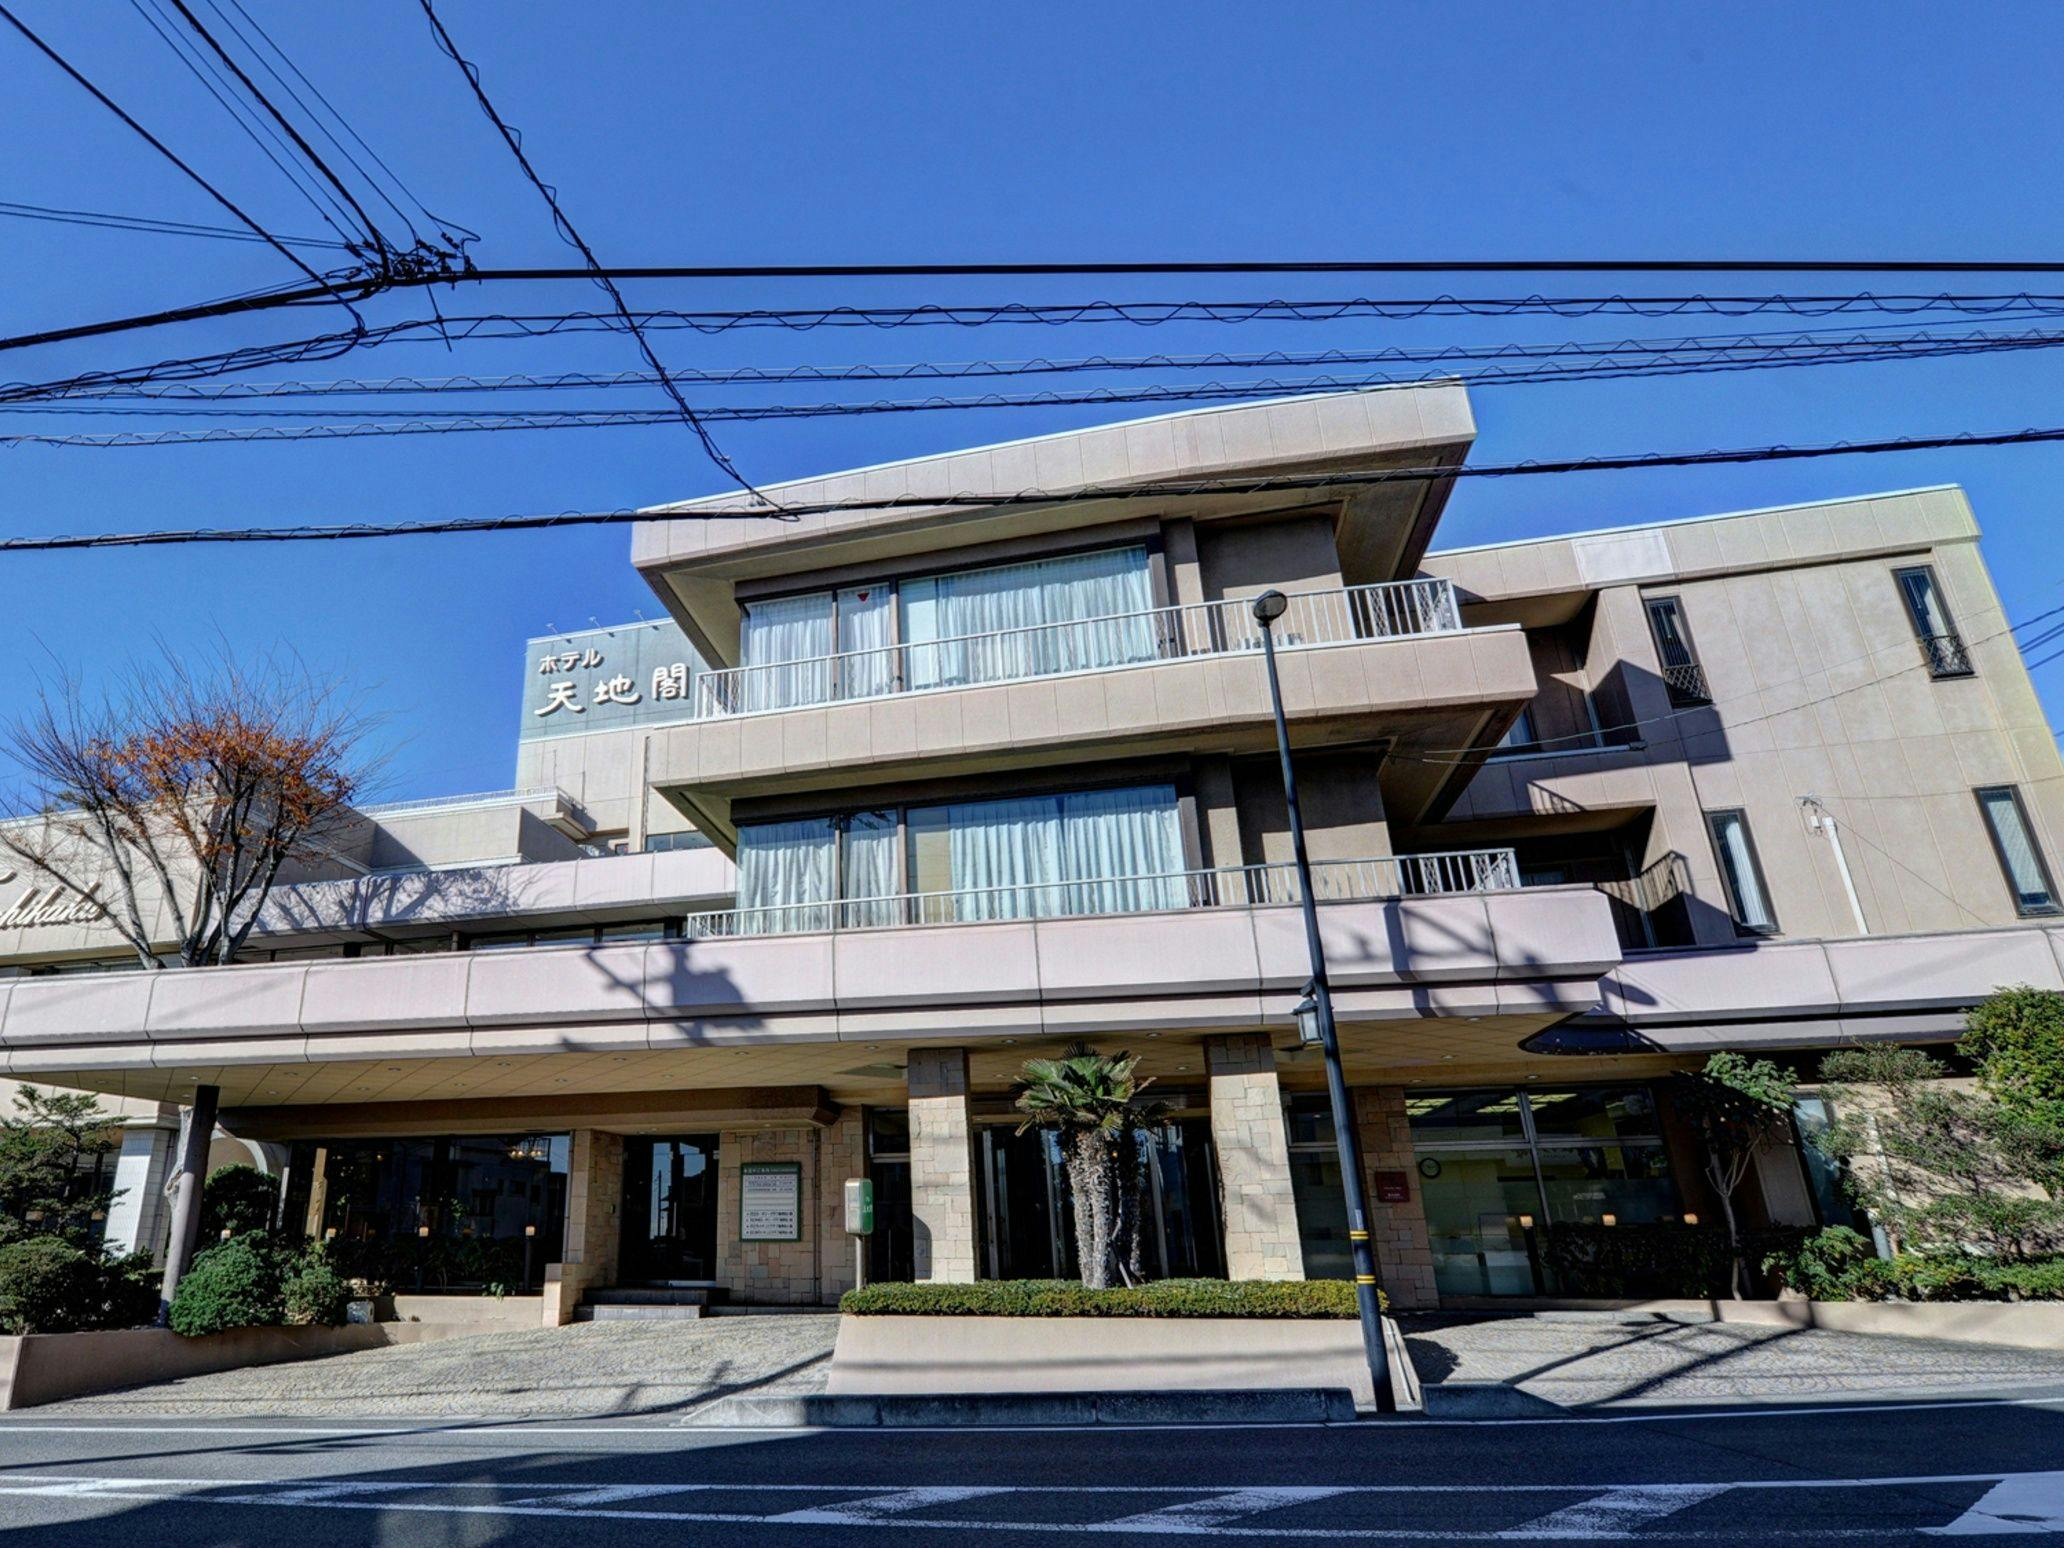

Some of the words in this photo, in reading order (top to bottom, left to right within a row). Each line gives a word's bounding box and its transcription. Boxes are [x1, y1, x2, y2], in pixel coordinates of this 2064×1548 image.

[539, 648, 603, 674] ホテル
[534, 663, 690, 717] 天地閣
